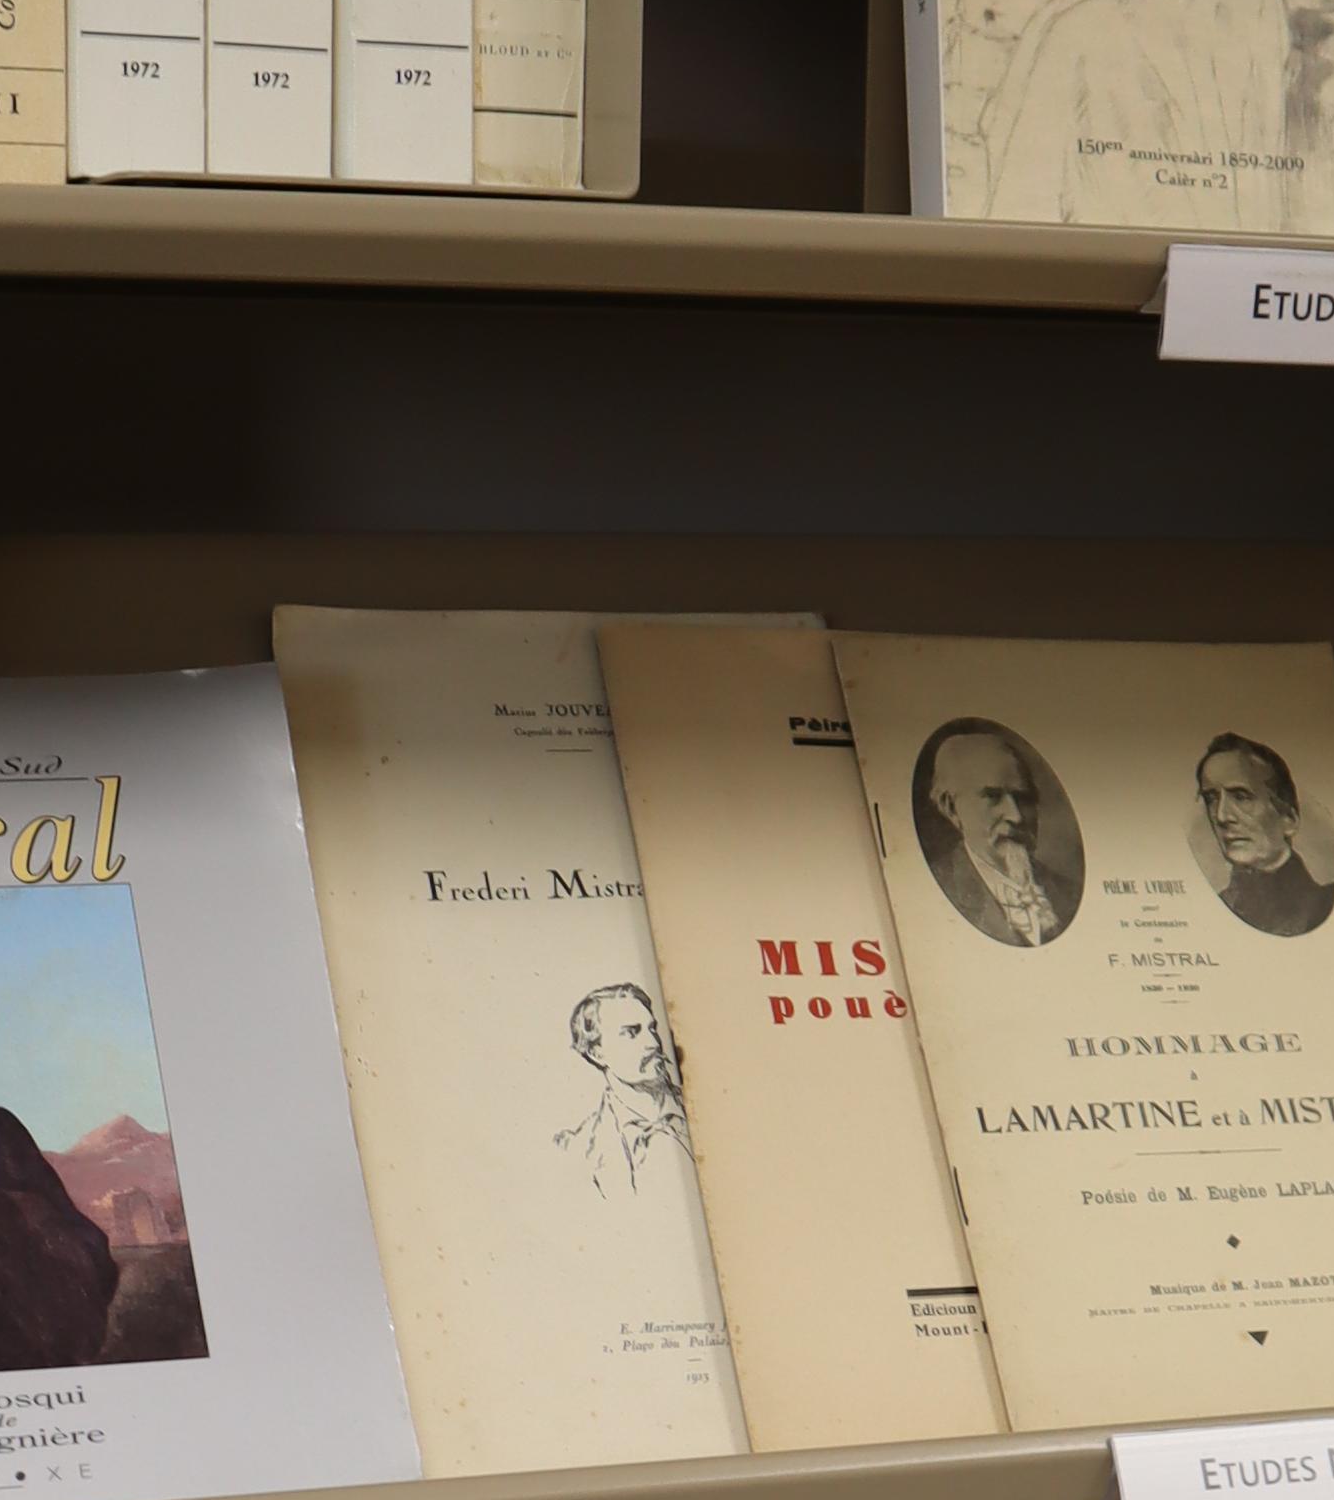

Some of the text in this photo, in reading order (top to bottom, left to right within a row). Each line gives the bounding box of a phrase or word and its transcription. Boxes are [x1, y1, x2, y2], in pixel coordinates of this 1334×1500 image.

[121, 61, 161, 80] 1972
[1220, 152, 1305, 171] 1859-2009
[0, 755, 65, 777] Sud
[422, 869, 644, 902] Frederi Mistra
[1108, 952, 1219, 967] F. MISTRAL
[1065, 1032, 1303, 1057] HOMMAGE
[976, 1099, 1203, 1135] LAMARTINE
[1211, 1109, 1232, 1126] et
[1239, 1110, 1251, 1126] à
[1081, 1189, 1137, 1206] Poésie
[1147, 1187, 1167, 1203] de
[1177, 1186, 1197, 1201] M.
[1207, 1185, 1268, 1203] Eugène
[1150, 1281, 1207, 1297] Musique
[1212, 1280, 1227, 1292] de
[1231, 1279, 1248, 1292] M.
[1253, 1277, 1284, 1290] Jean
